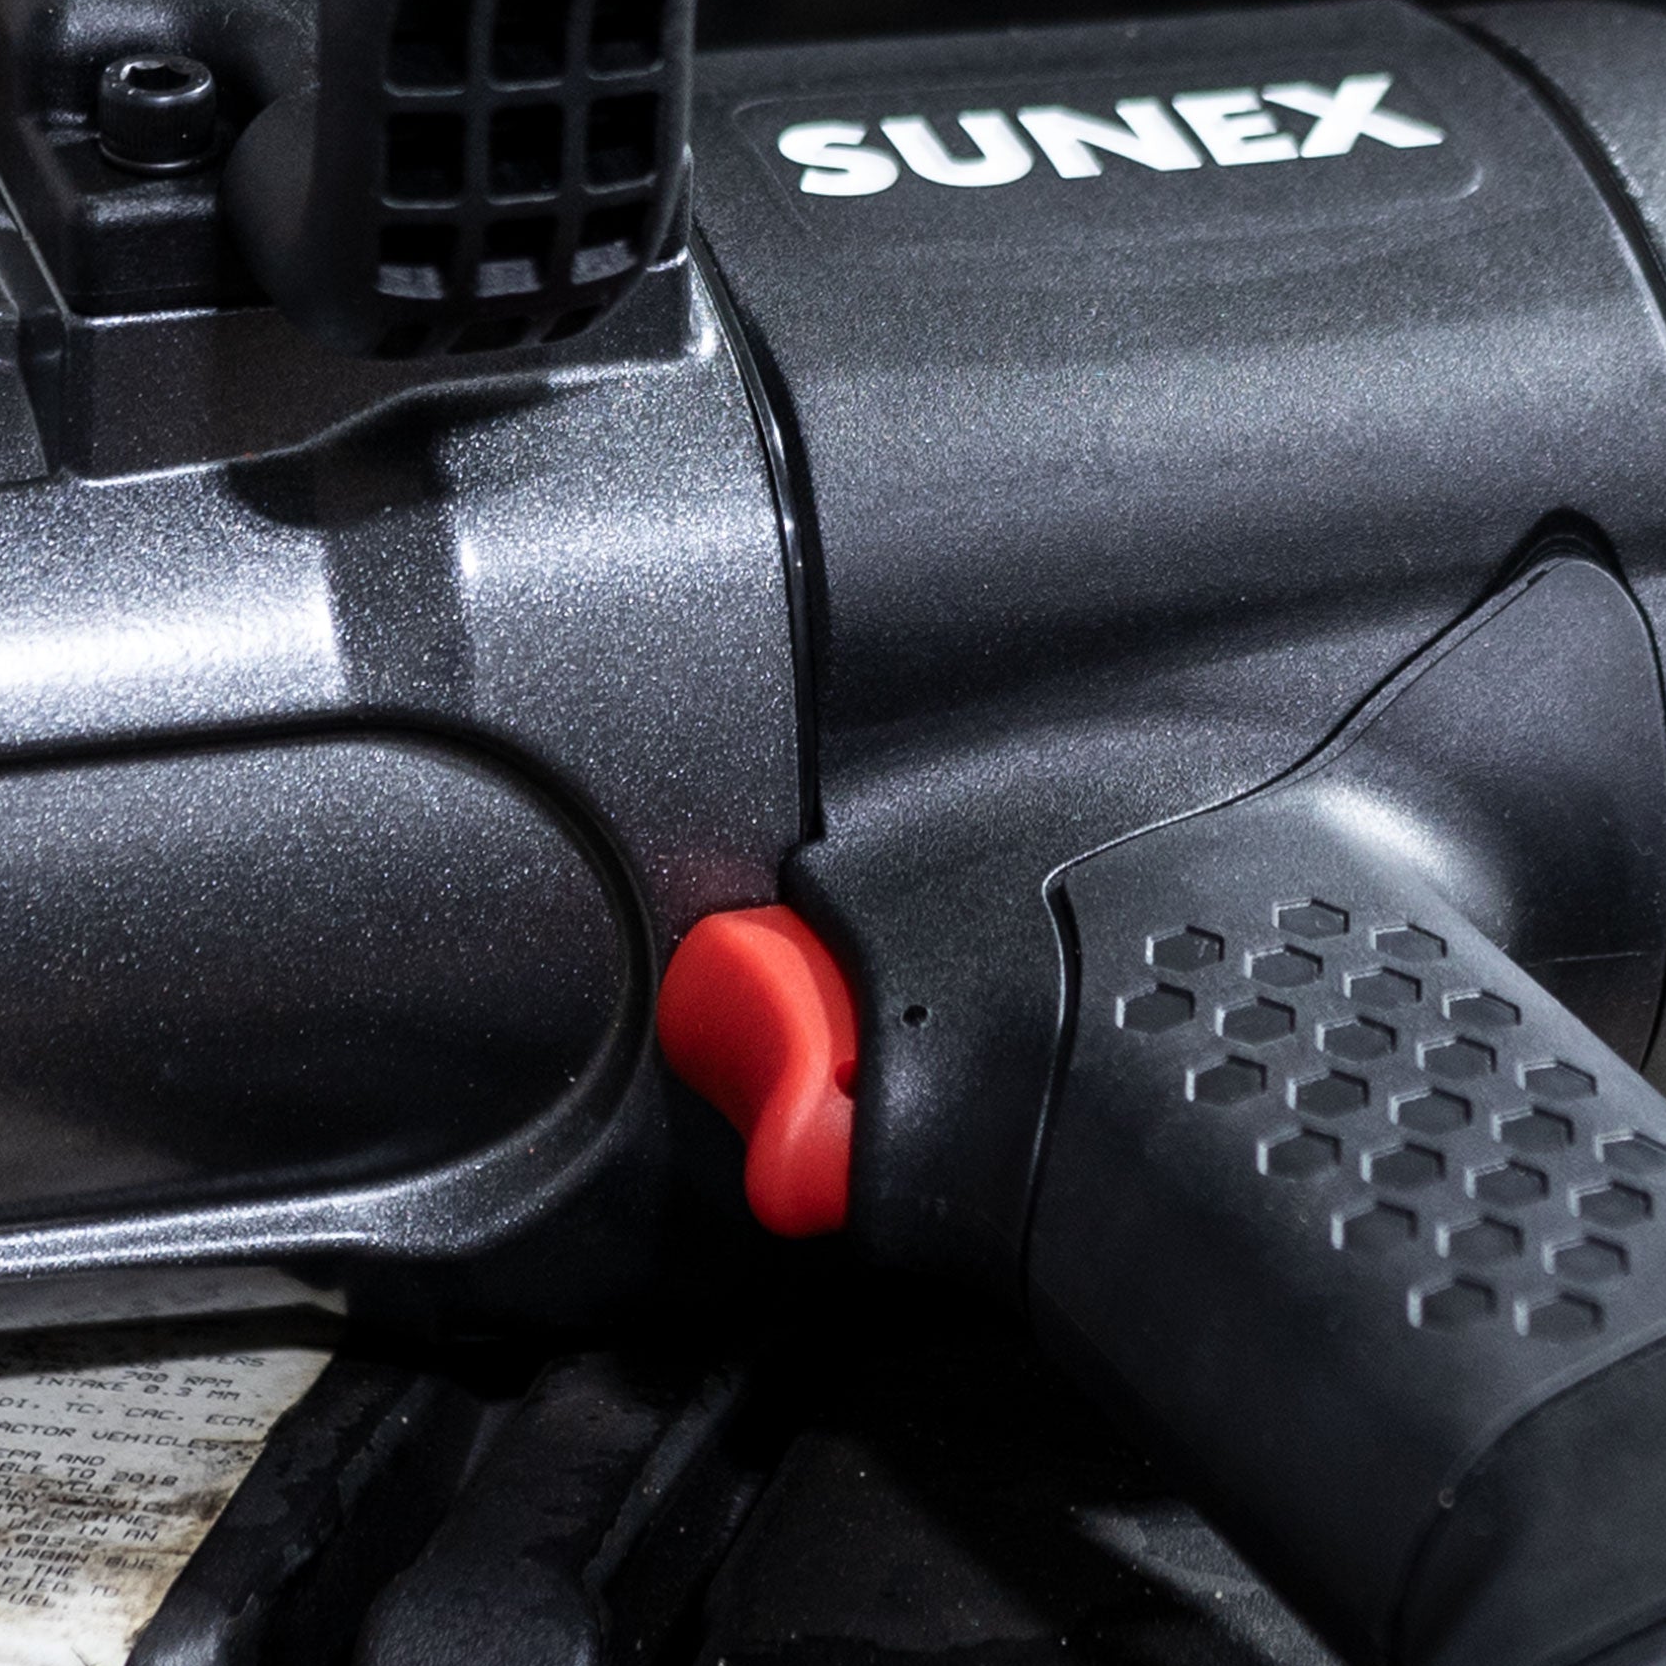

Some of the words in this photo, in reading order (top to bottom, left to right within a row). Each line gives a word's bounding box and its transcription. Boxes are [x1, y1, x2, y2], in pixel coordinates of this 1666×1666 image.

[778, 71, 1445, 197] SUNEX
[117, 1370, 172, 1383] 700
[181, 1375, 236, 1388] RPM
[31, 1376, 130, 1392] INTAKE
[139, 1384, 194, 1397] 0.3
[204, 1390, 243, 1401] MM
[53, 1452, 109, 1466] AND
[62, 1467, 100, 1479] TO
[107, 1471, 182, 1487] 2018
[33, 1478, 122, 1495] CYCLE
[76, 1524, 111, 1535] IN
[120, 1528, 162, 1541] AN
[0, 1546, 94, 1563] URBAN
[27, 1563, 81, 1578] THE
